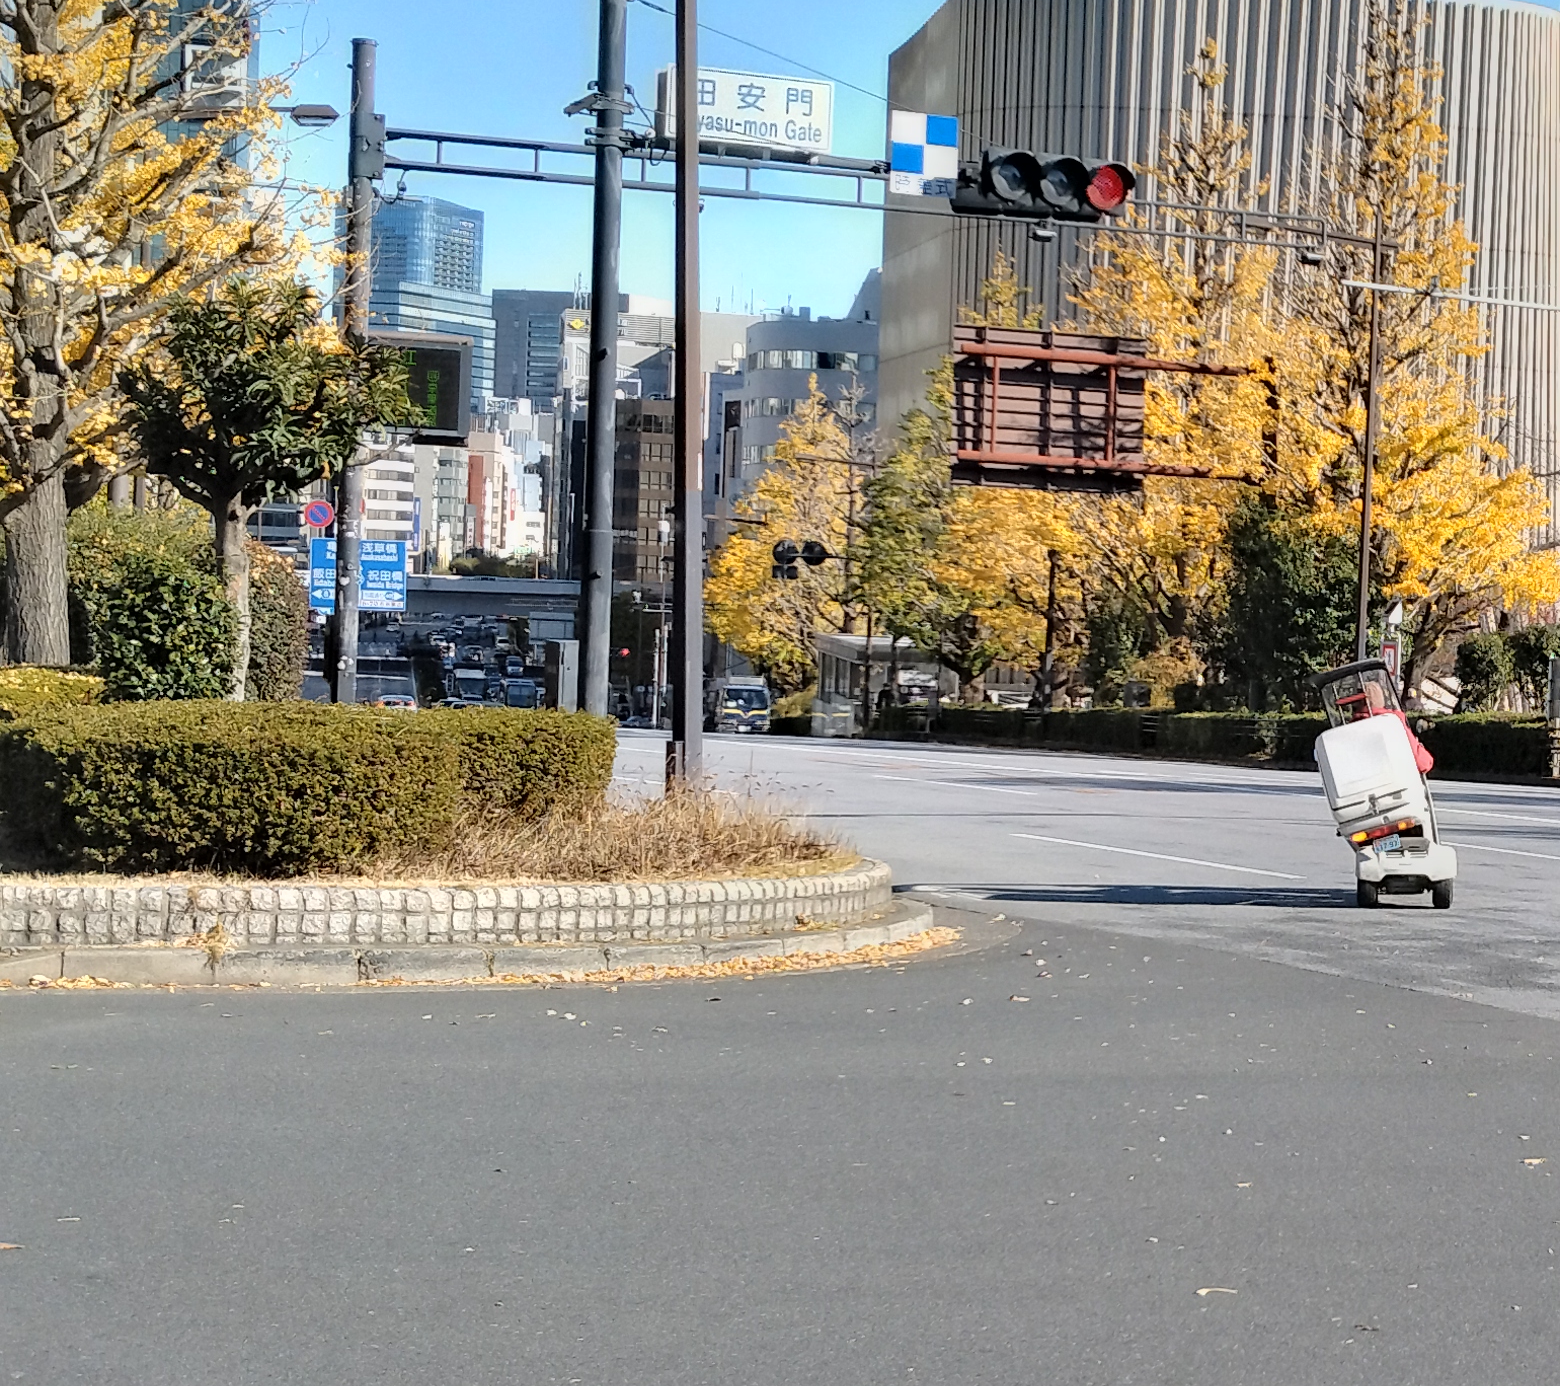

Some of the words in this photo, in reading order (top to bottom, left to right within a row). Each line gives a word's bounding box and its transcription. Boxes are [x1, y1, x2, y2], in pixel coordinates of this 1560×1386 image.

[697, 78, 813, 117] 田安門
[697, 114, 778, 139] yasu-mon
[784, 119, 823, 144] Gate
[313, 568, 336, 579] 飯田
